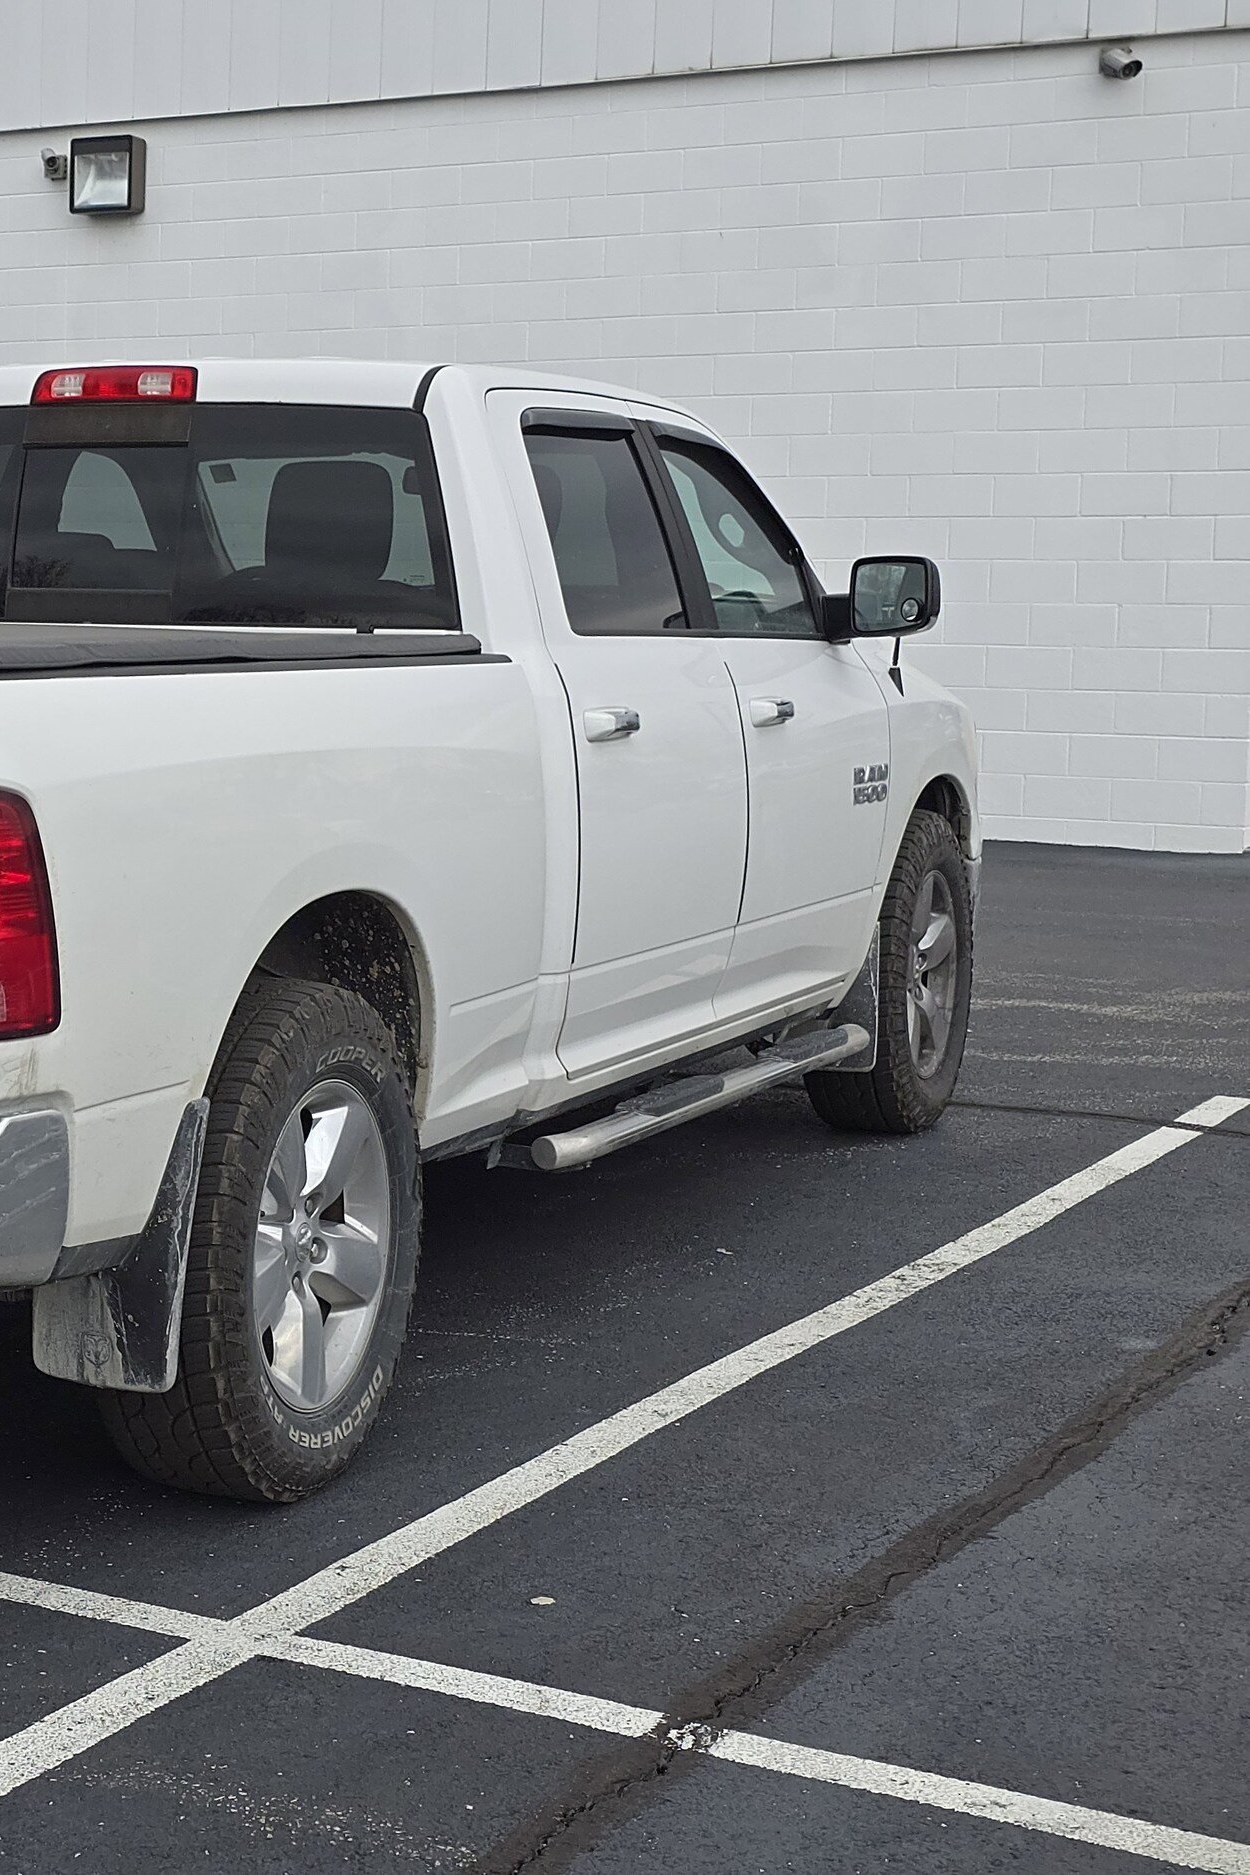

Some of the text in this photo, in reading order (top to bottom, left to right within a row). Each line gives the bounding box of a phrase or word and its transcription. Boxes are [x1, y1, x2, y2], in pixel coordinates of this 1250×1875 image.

[853, 764, 889, 785] RAM
[853, 783, 888, 806] 1500
[315, 1045, 387, 1083] COOPER
[288, 1364, 384, 1449] DISCOVERER
